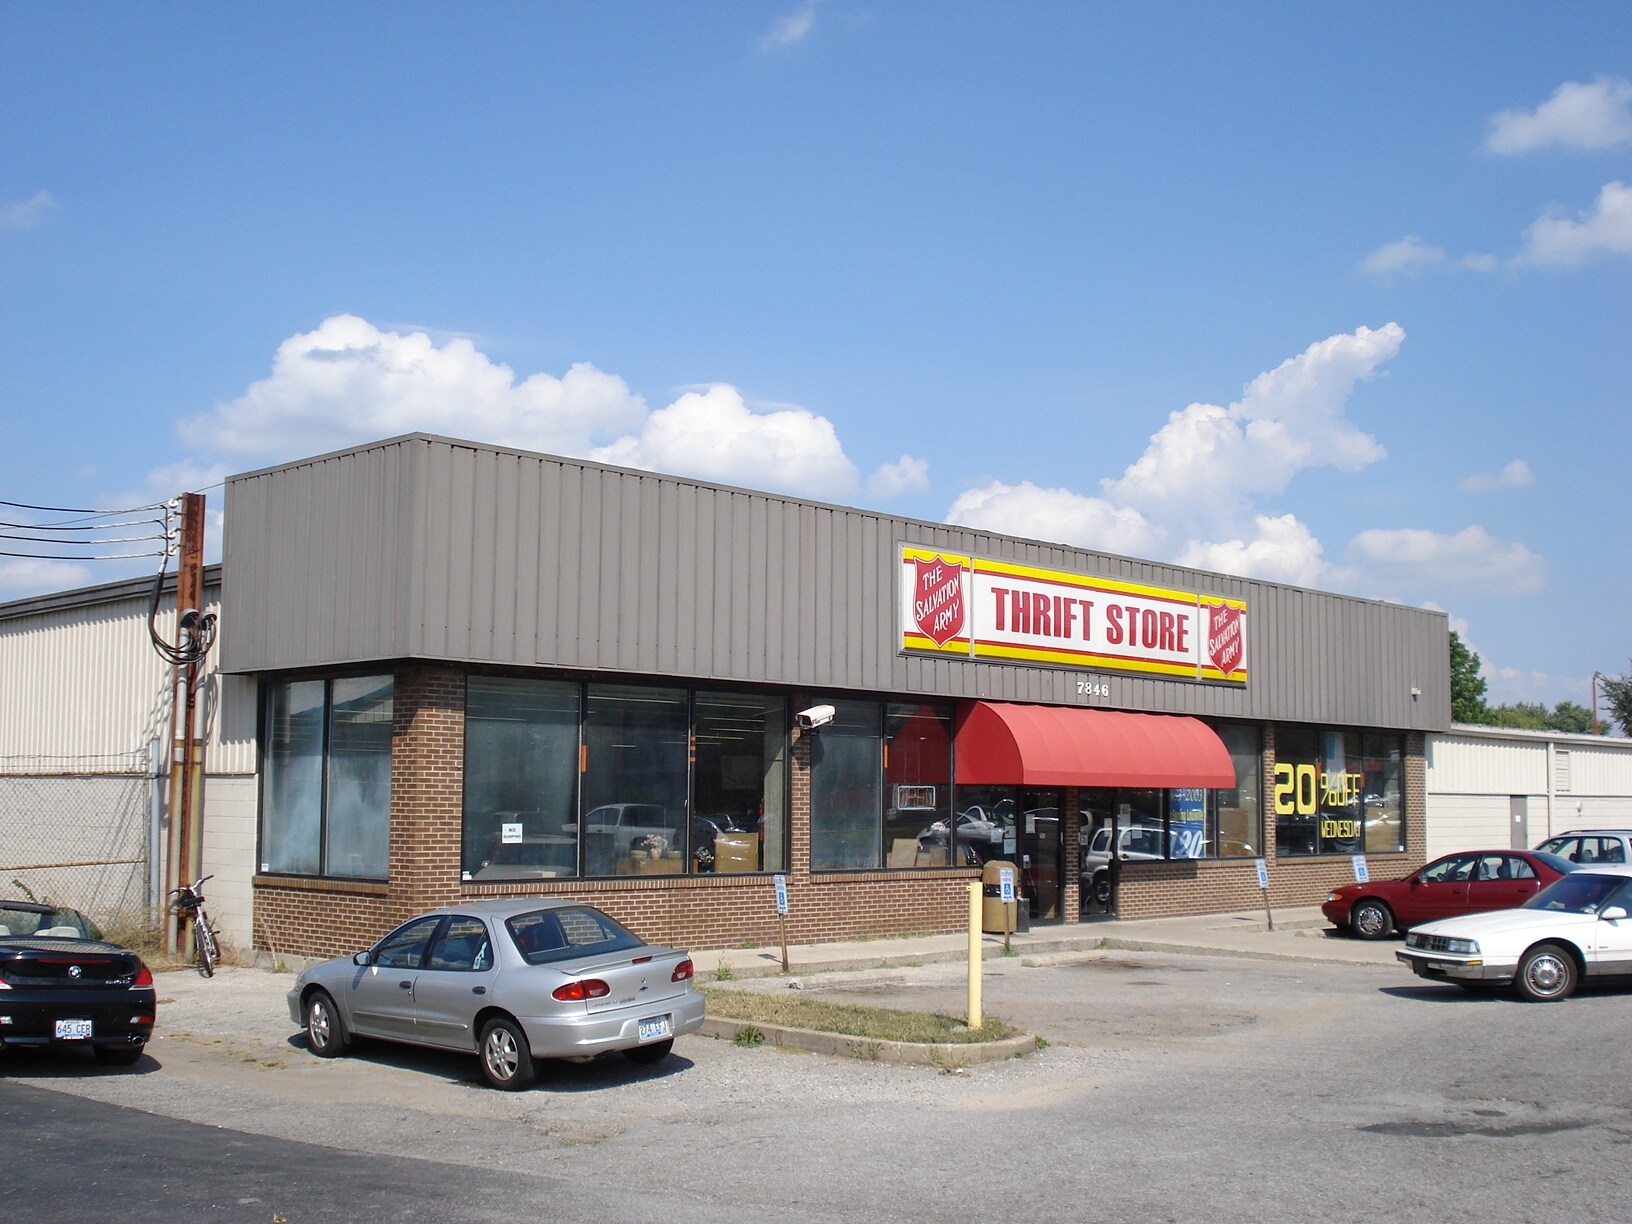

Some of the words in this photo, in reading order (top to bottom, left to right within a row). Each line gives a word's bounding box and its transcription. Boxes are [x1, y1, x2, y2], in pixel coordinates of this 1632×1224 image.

[922, 565, 943, 591] THE
[915, 573, 960, 622] SALVATION
[932, 599, 960, 635] ARMY
[991, 587, 1094, 641] THRIFT
[1106, 604, 1190, 653] STORE
[1213, 609, 1228, 631] THE
[1209, 615, 1240, 657] SALVATION
[1220, 636, 1240, 668] ARMY
[1076, 681, 1109, 697] 7846
[57, 1024, 72, 1034] 645
[76, 1024, 91, 1034] CER
